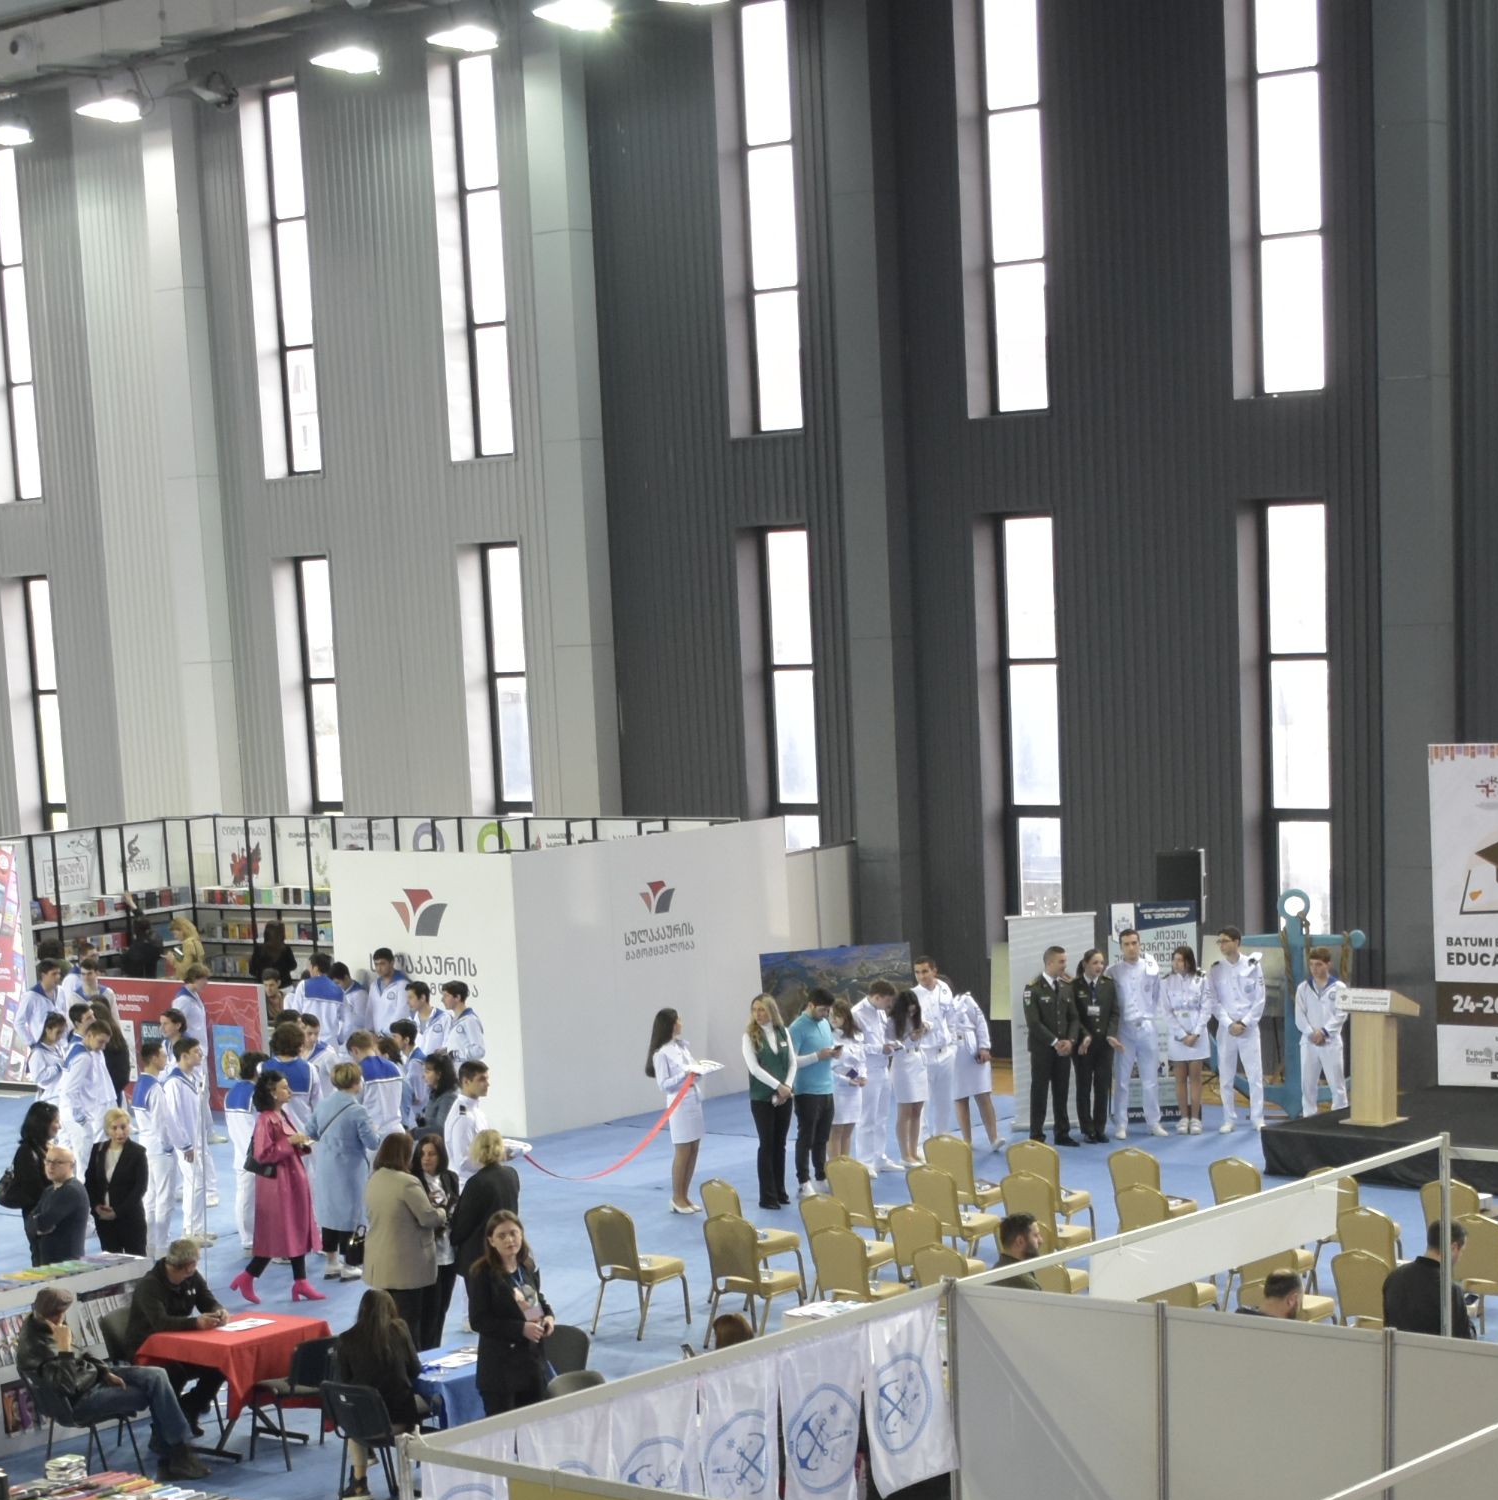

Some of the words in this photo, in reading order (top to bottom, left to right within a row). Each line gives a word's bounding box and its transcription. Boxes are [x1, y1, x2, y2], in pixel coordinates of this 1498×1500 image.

[624, 922, 694, 946] სულაკაურის
[1154, 930, 1187, 940] კიევის
[1446, 936, 1492, 947] BATUMI
[625, 940, 695, 960] გამომცემლობა
